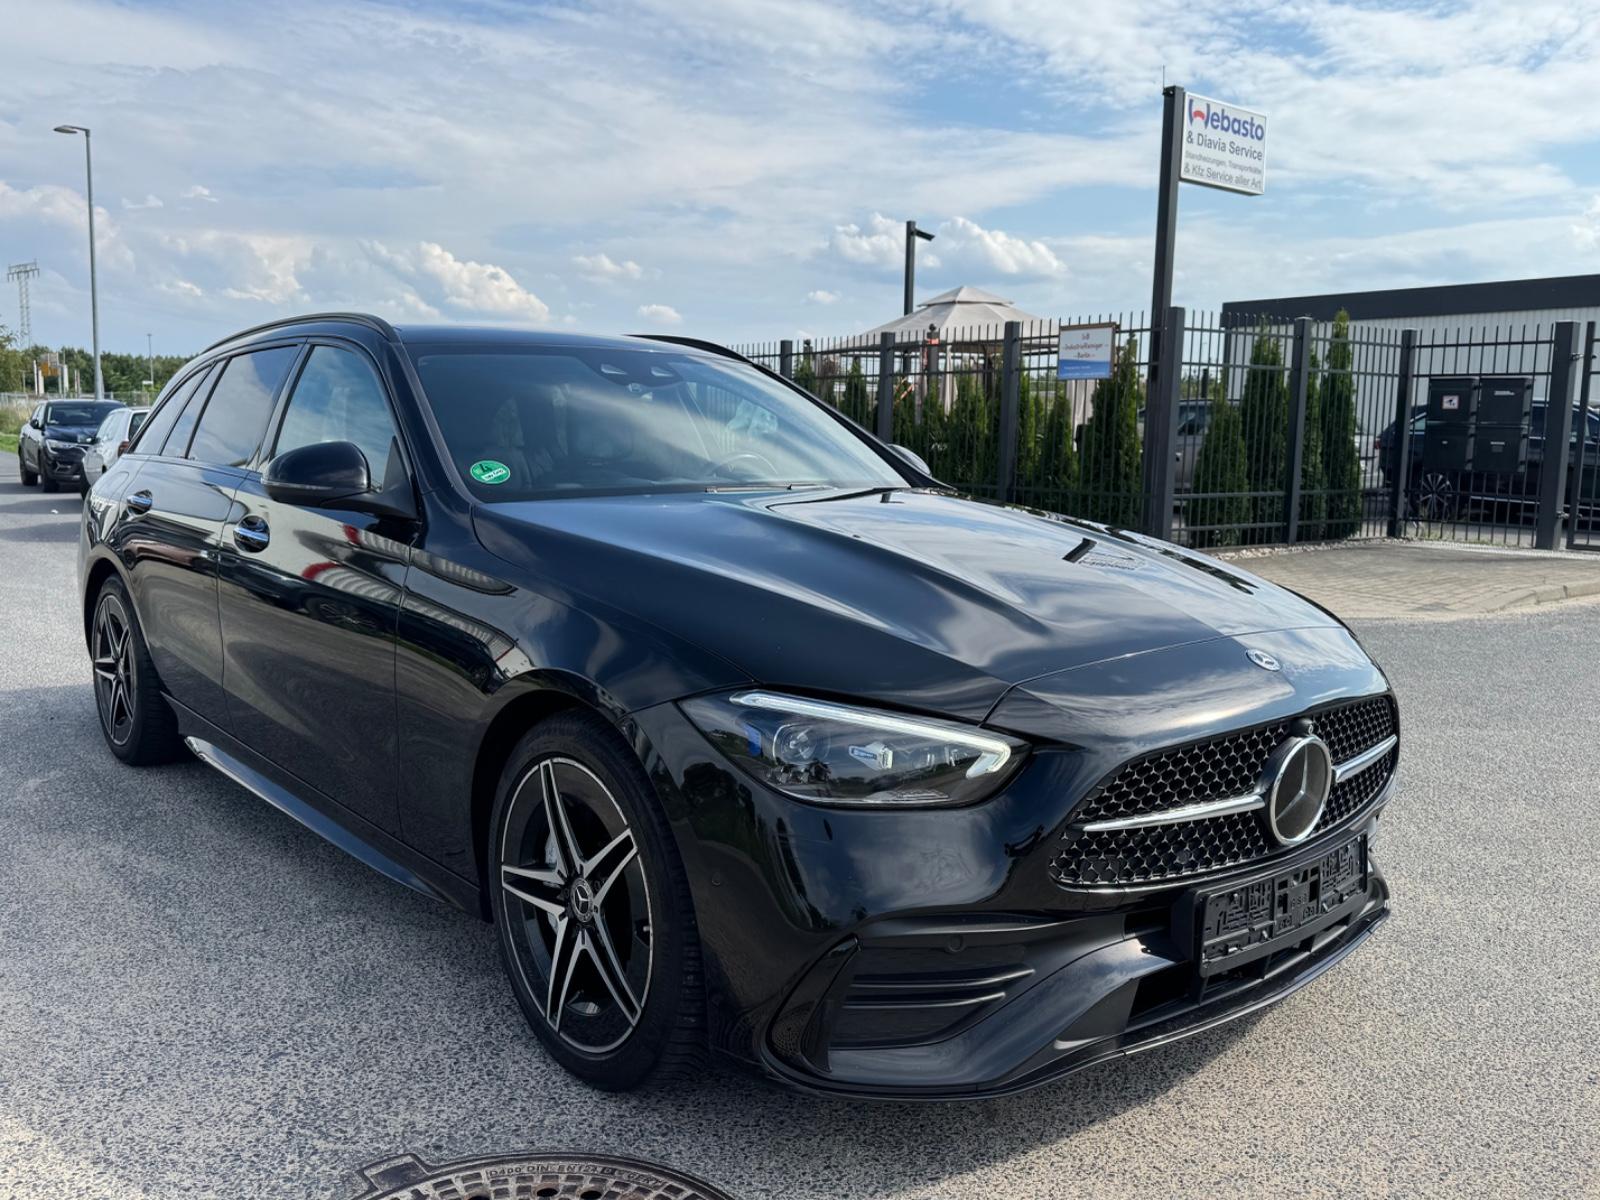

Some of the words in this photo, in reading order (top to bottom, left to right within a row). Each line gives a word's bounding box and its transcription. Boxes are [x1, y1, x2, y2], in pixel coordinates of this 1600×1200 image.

[1188, 98, 1265, 141] Webasto
[1186, 130, 1194, 145] &
[1197, 132, 1227, 152] Diavia
[1229, 141, 1263, 160] Service
[1184, 163, 1191, 174] &
[1192, 164, 1205, 177] Kfz
[1206, 167, 1233, 183] Service
[490, 1166, 522, 1177] D400
